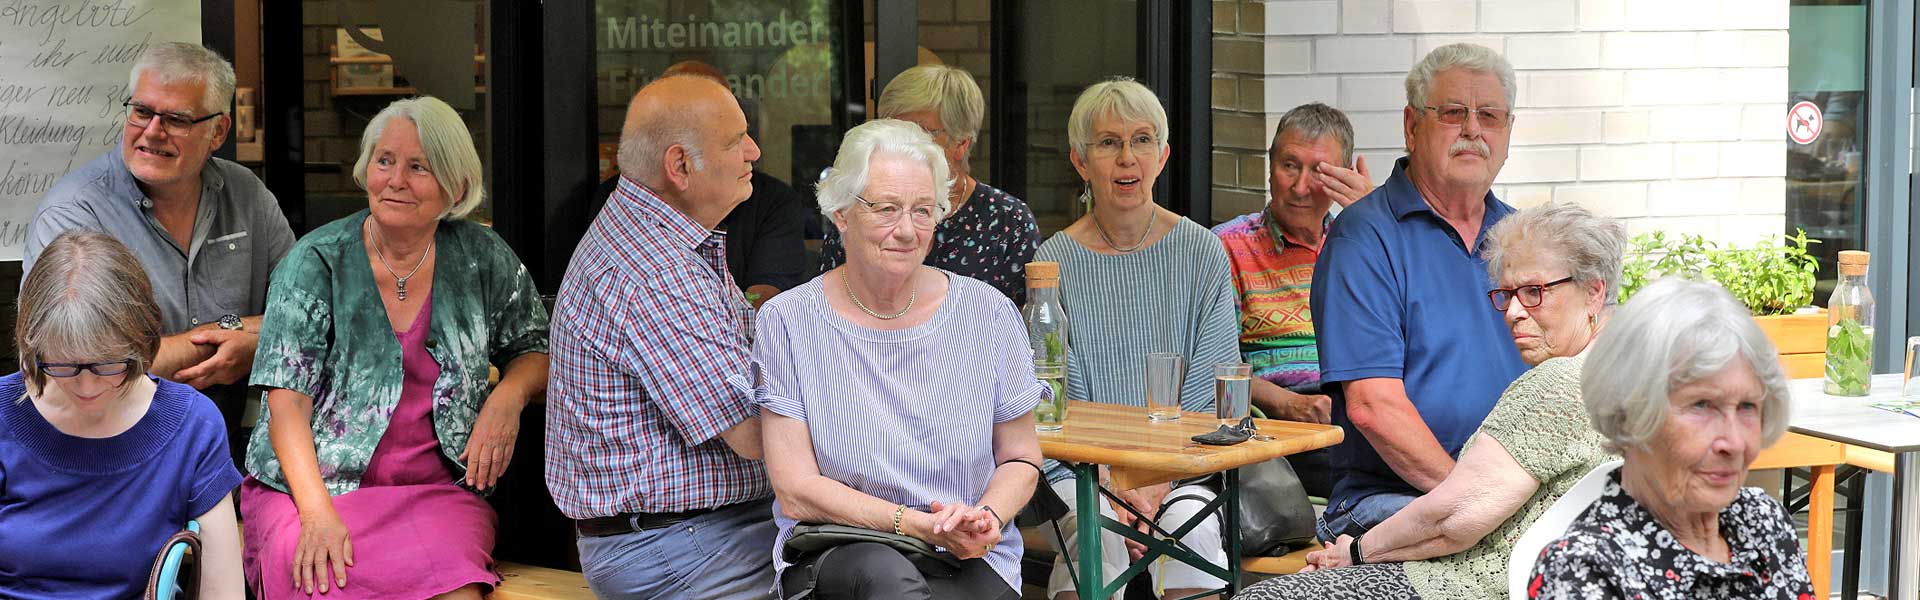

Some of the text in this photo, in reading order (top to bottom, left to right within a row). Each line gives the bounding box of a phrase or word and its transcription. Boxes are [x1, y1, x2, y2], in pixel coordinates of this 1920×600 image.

[2, 0, 153, 47] Angebote
[607, 8, 824, 49] Miteinander
[24, 38, 88, 69] ihr
[48, 85, 94, 107] neu
